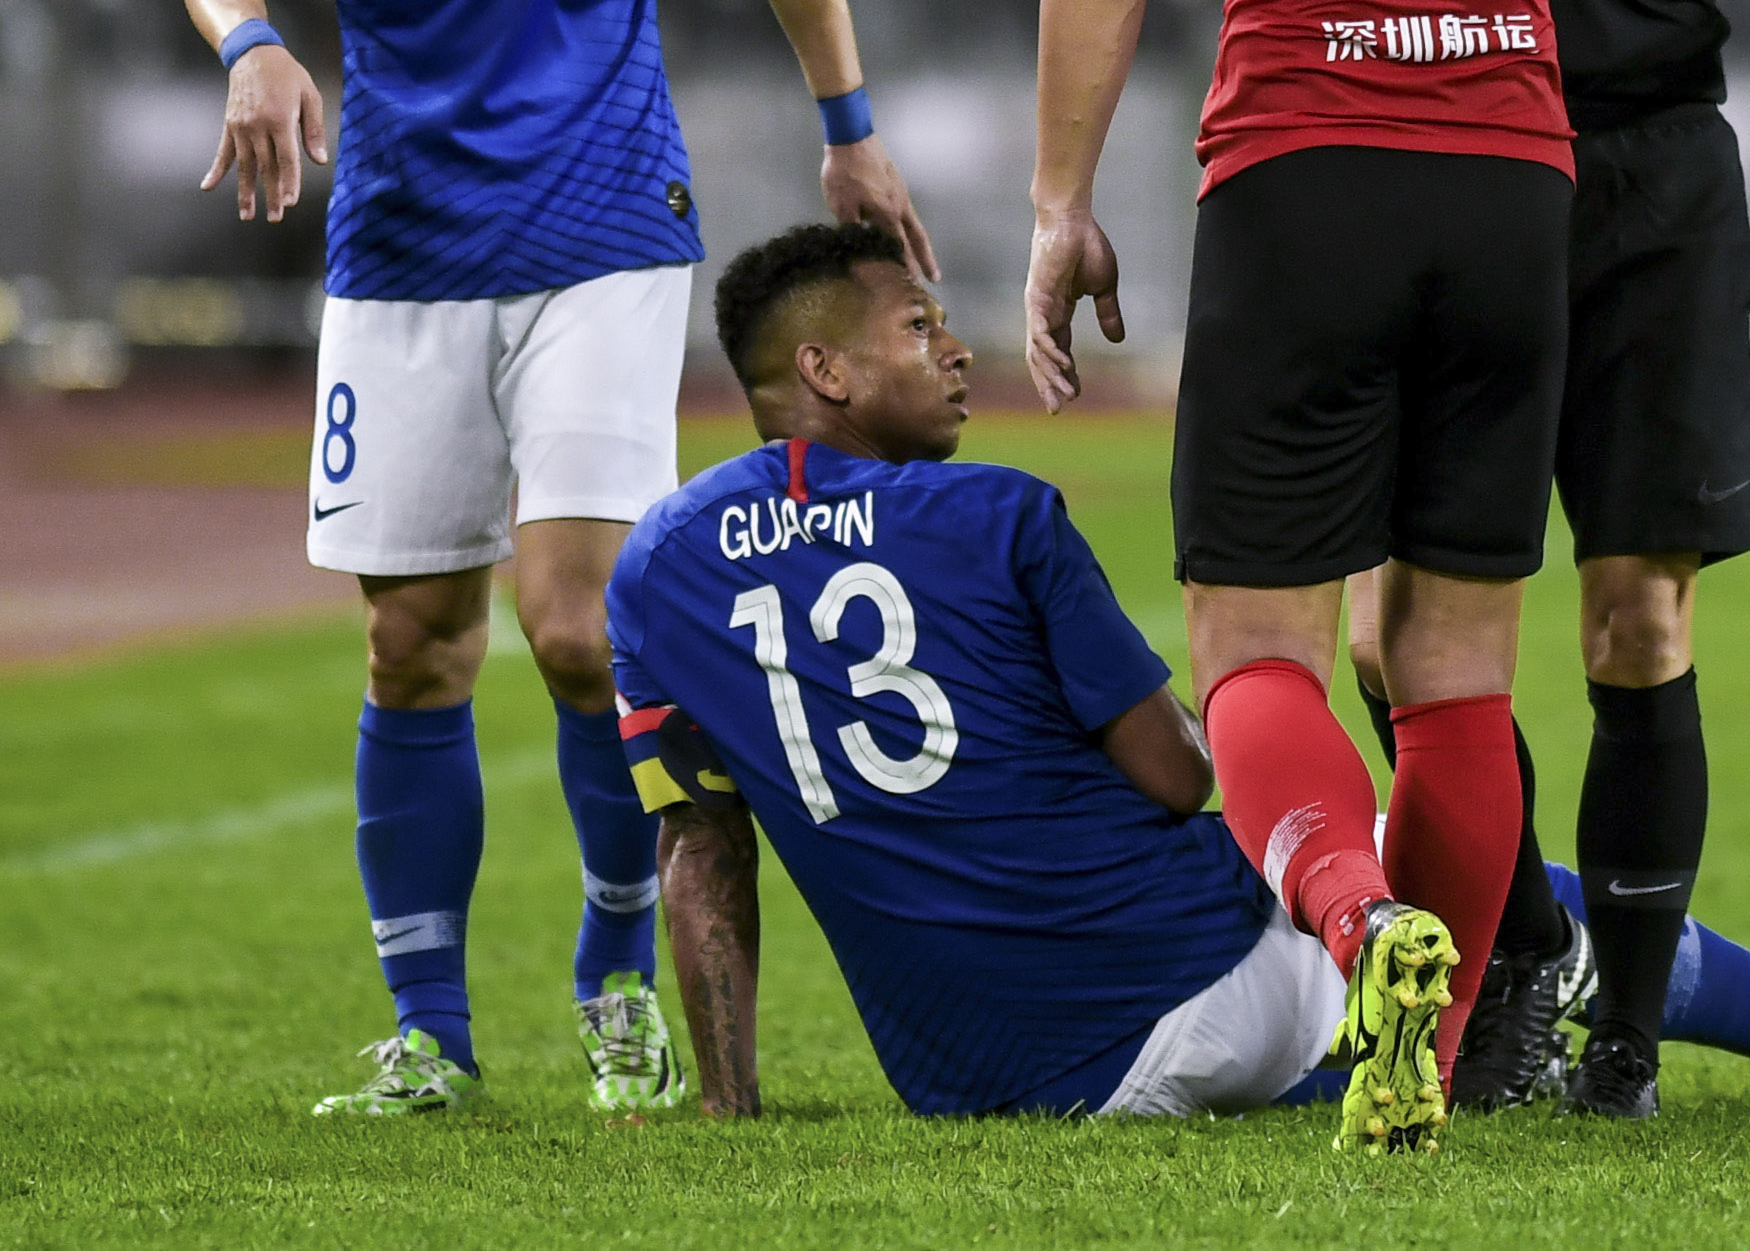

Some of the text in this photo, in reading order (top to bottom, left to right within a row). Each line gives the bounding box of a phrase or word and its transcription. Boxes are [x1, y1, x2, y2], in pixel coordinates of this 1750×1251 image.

[1320, 13, 1540, 64] 深圳航运
[322, 382, 357, 485] 8
[728, 561, 960, 826] 13
